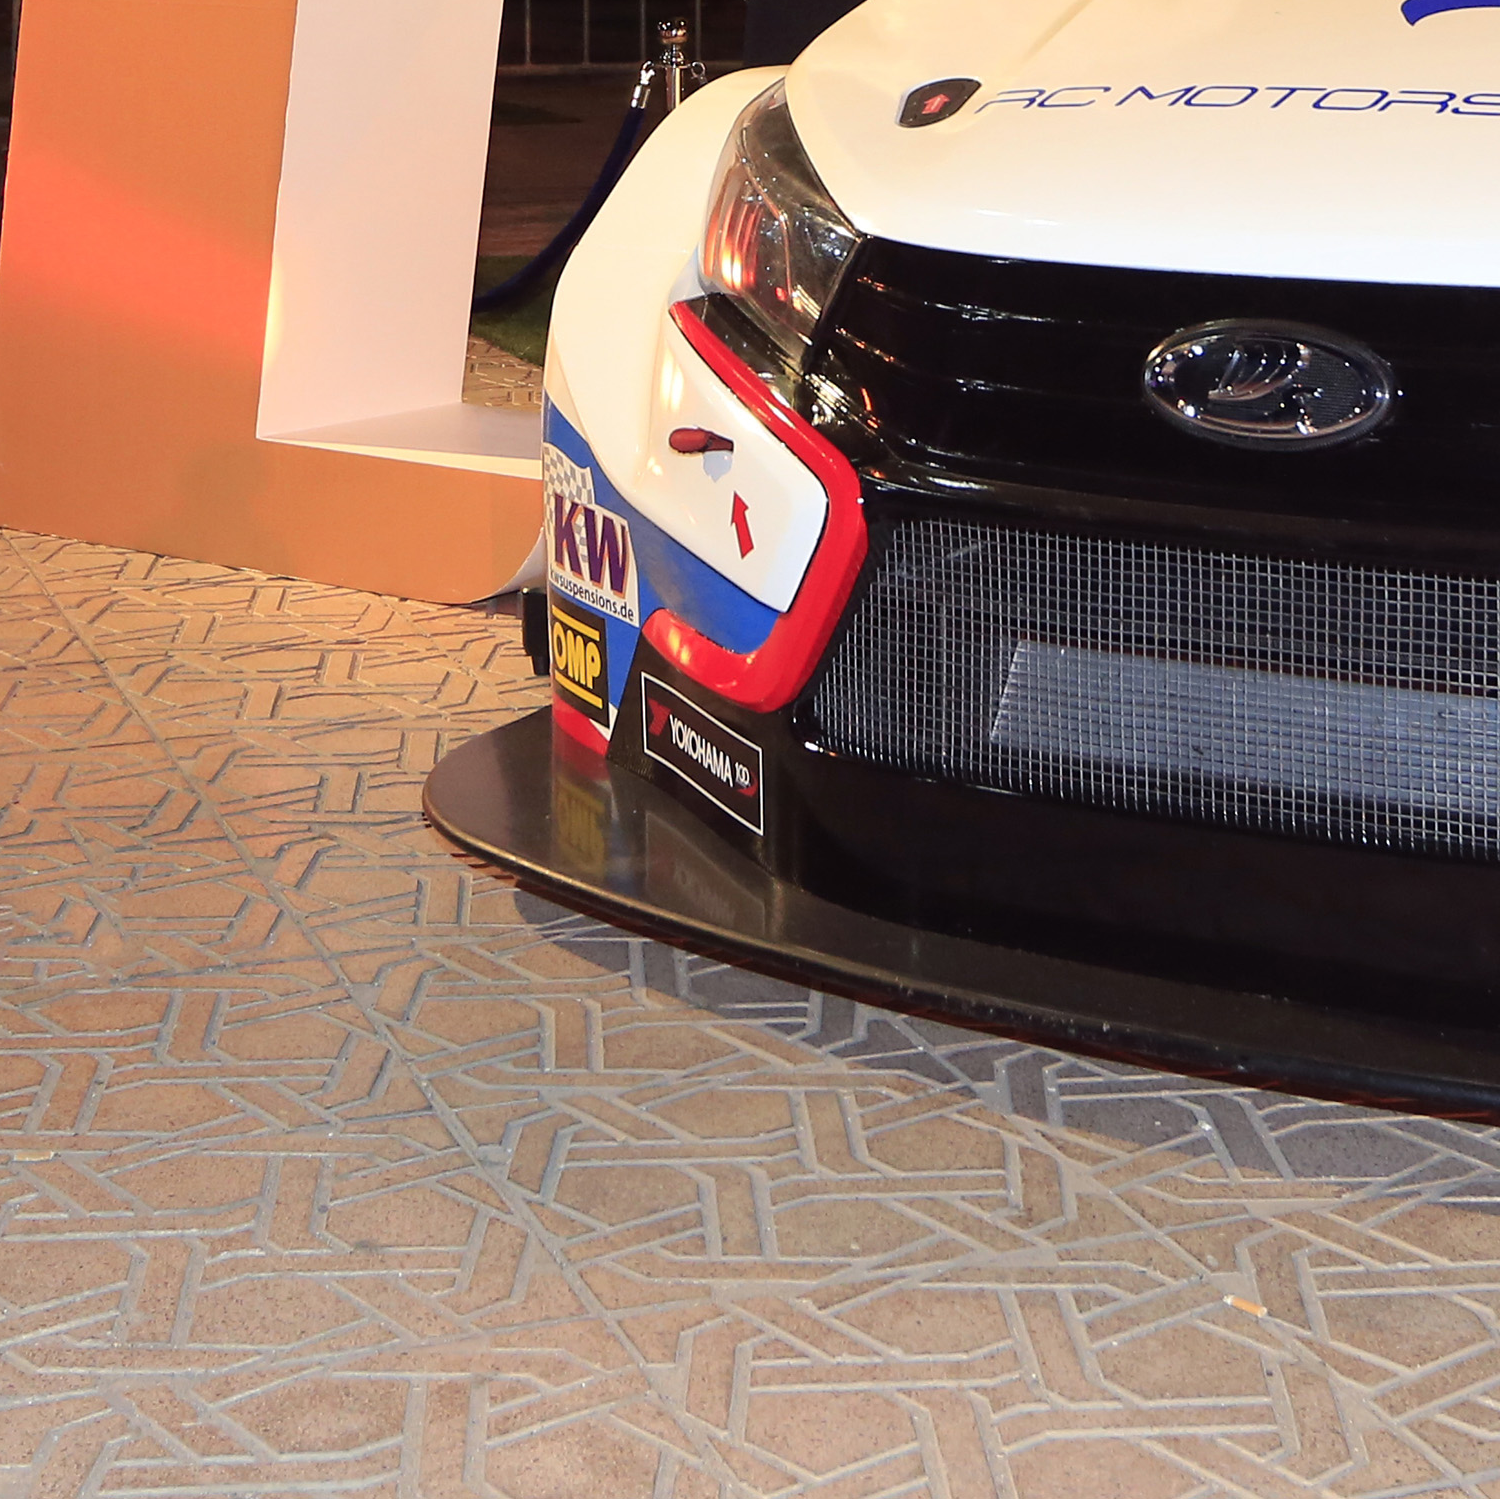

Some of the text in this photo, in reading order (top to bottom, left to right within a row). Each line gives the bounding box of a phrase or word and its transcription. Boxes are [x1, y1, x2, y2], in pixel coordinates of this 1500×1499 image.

[974, 86, 1112, 114] RC
[553, 492, 630, 598] KW
[550, 569, 635, 623] kwsuspensions.de
[552, 622, 601, 689] OMP
[669, 714, 734, 788] YOKOHAMA
